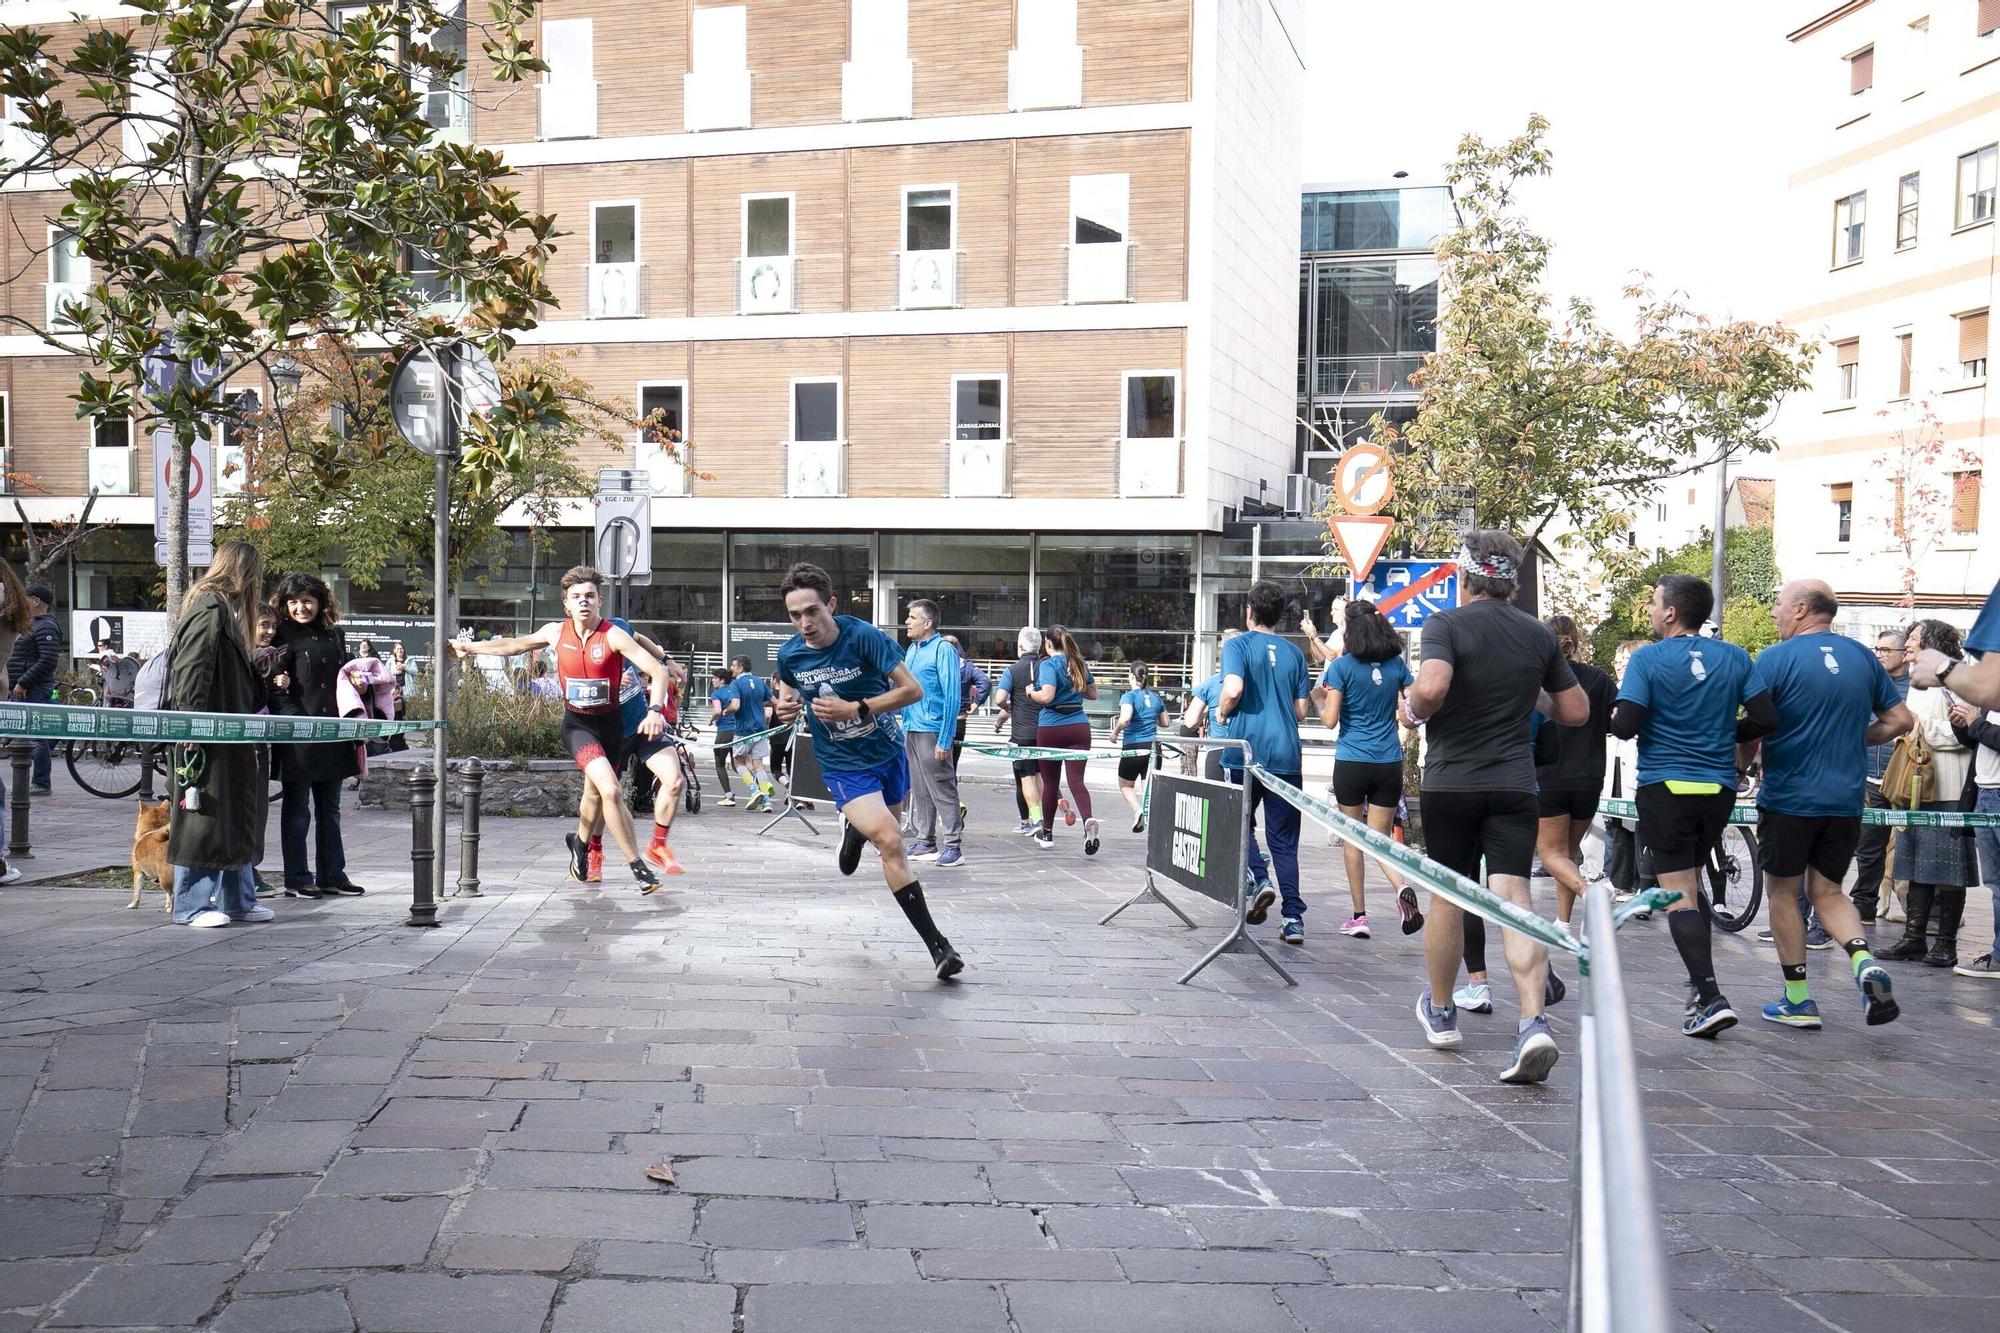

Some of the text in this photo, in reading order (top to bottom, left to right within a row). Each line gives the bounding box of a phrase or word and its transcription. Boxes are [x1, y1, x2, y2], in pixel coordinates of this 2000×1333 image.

[804, 668, 852, 685] ALMENDRA
[68, 712, 91, 723] VITORIA
[132, 716, 153, 726] VITORIA
[68, 722, 91, 733] GASTEIZ
[132, 725, 153, 735] GASTEIZ
[1175, 792, 1202, 835] VITORIA
[1172, 830, 1201, 875] GASTEIZ
